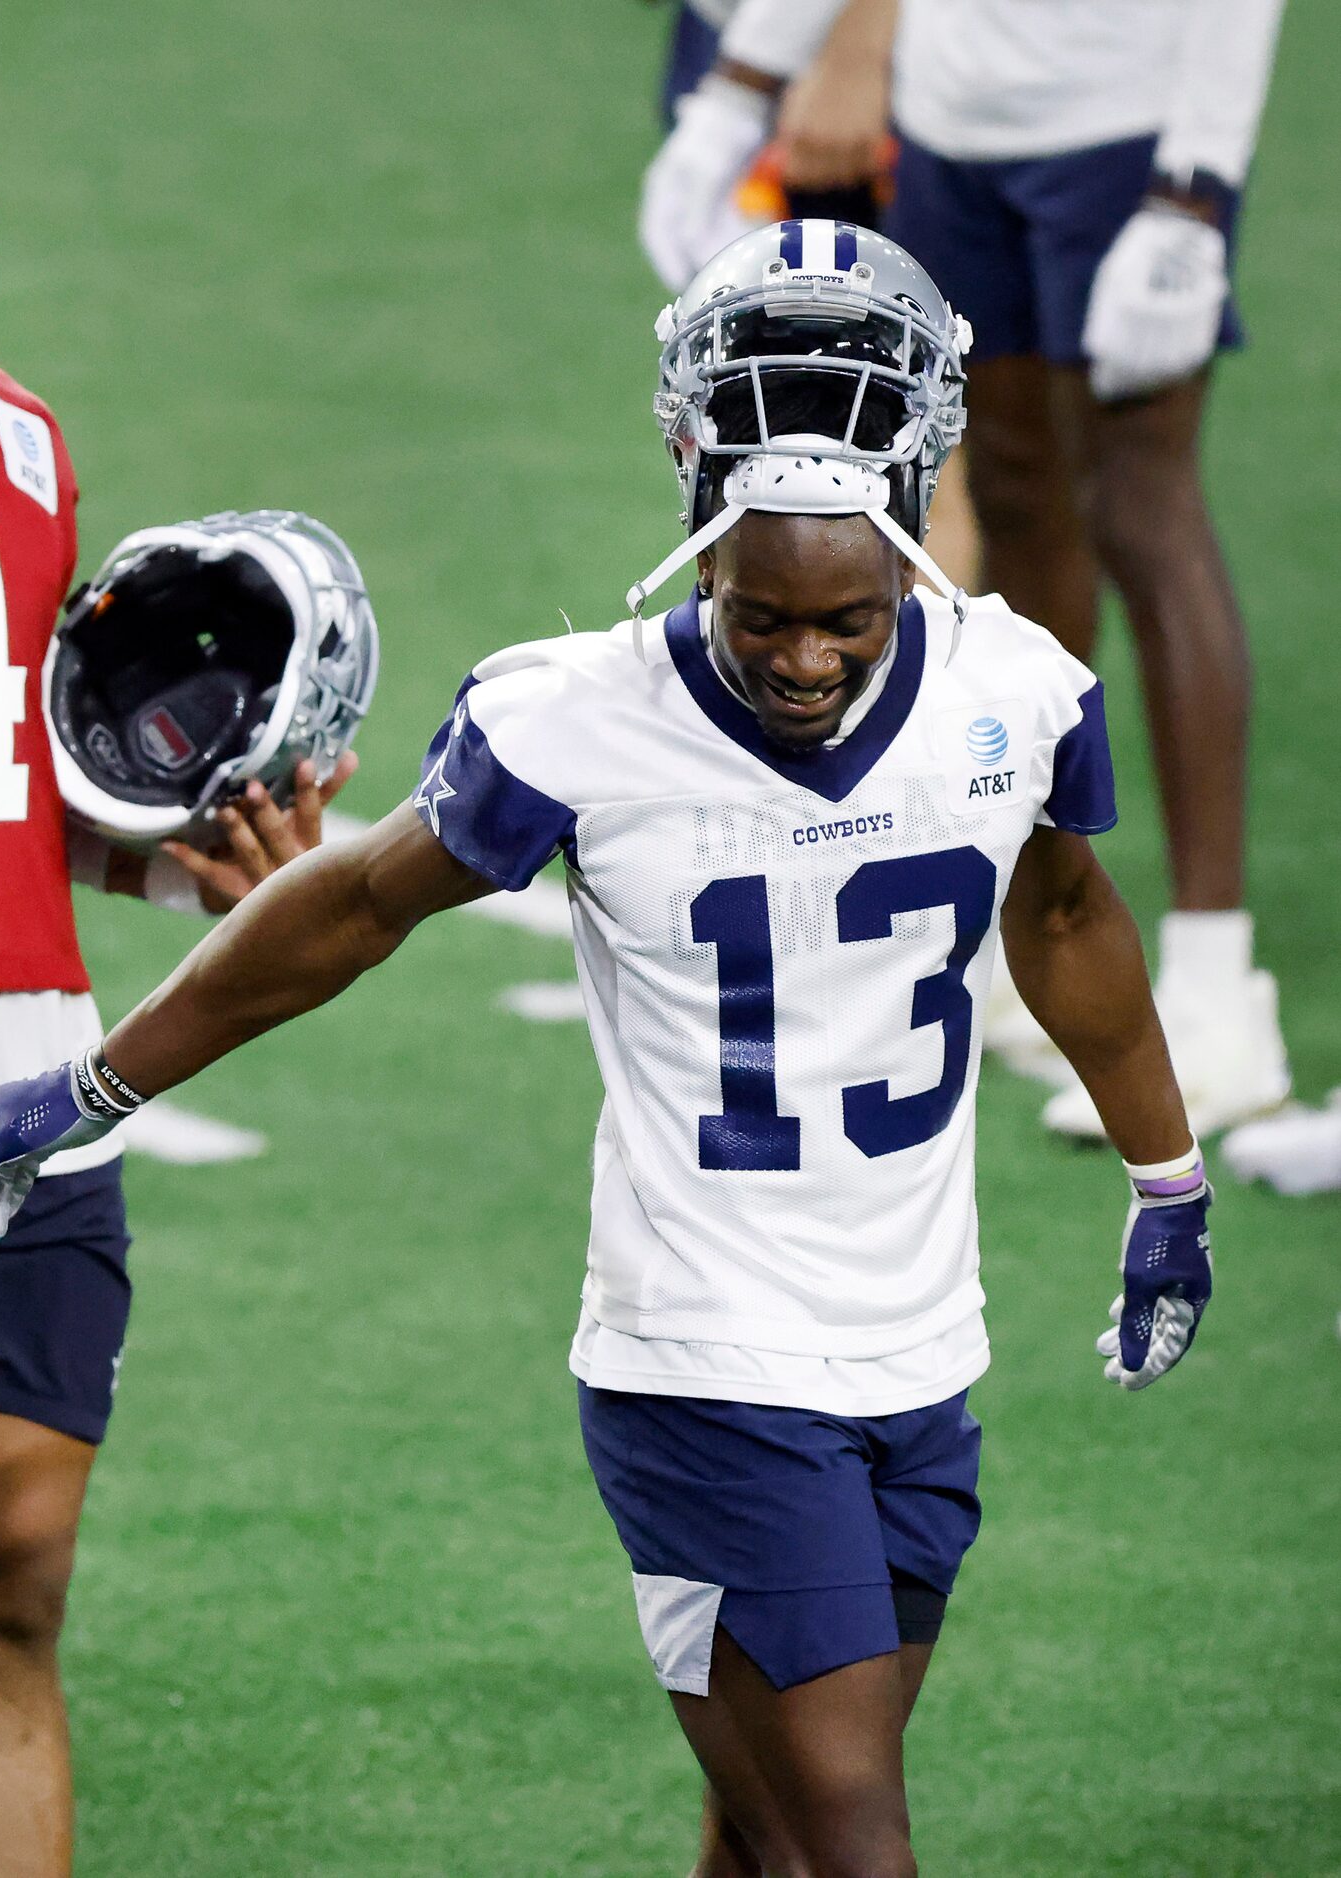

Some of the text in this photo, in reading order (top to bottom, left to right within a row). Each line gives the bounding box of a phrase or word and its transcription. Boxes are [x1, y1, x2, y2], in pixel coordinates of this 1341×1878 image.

[968, 770, 1016, 799] AT&T
[792, 812, 893, 846] COWBOYS
[690, 845, 996, 1173] 13
[101, 1065, 120, 1086] 8:31
[88, 1092, 107, 1107] AM
